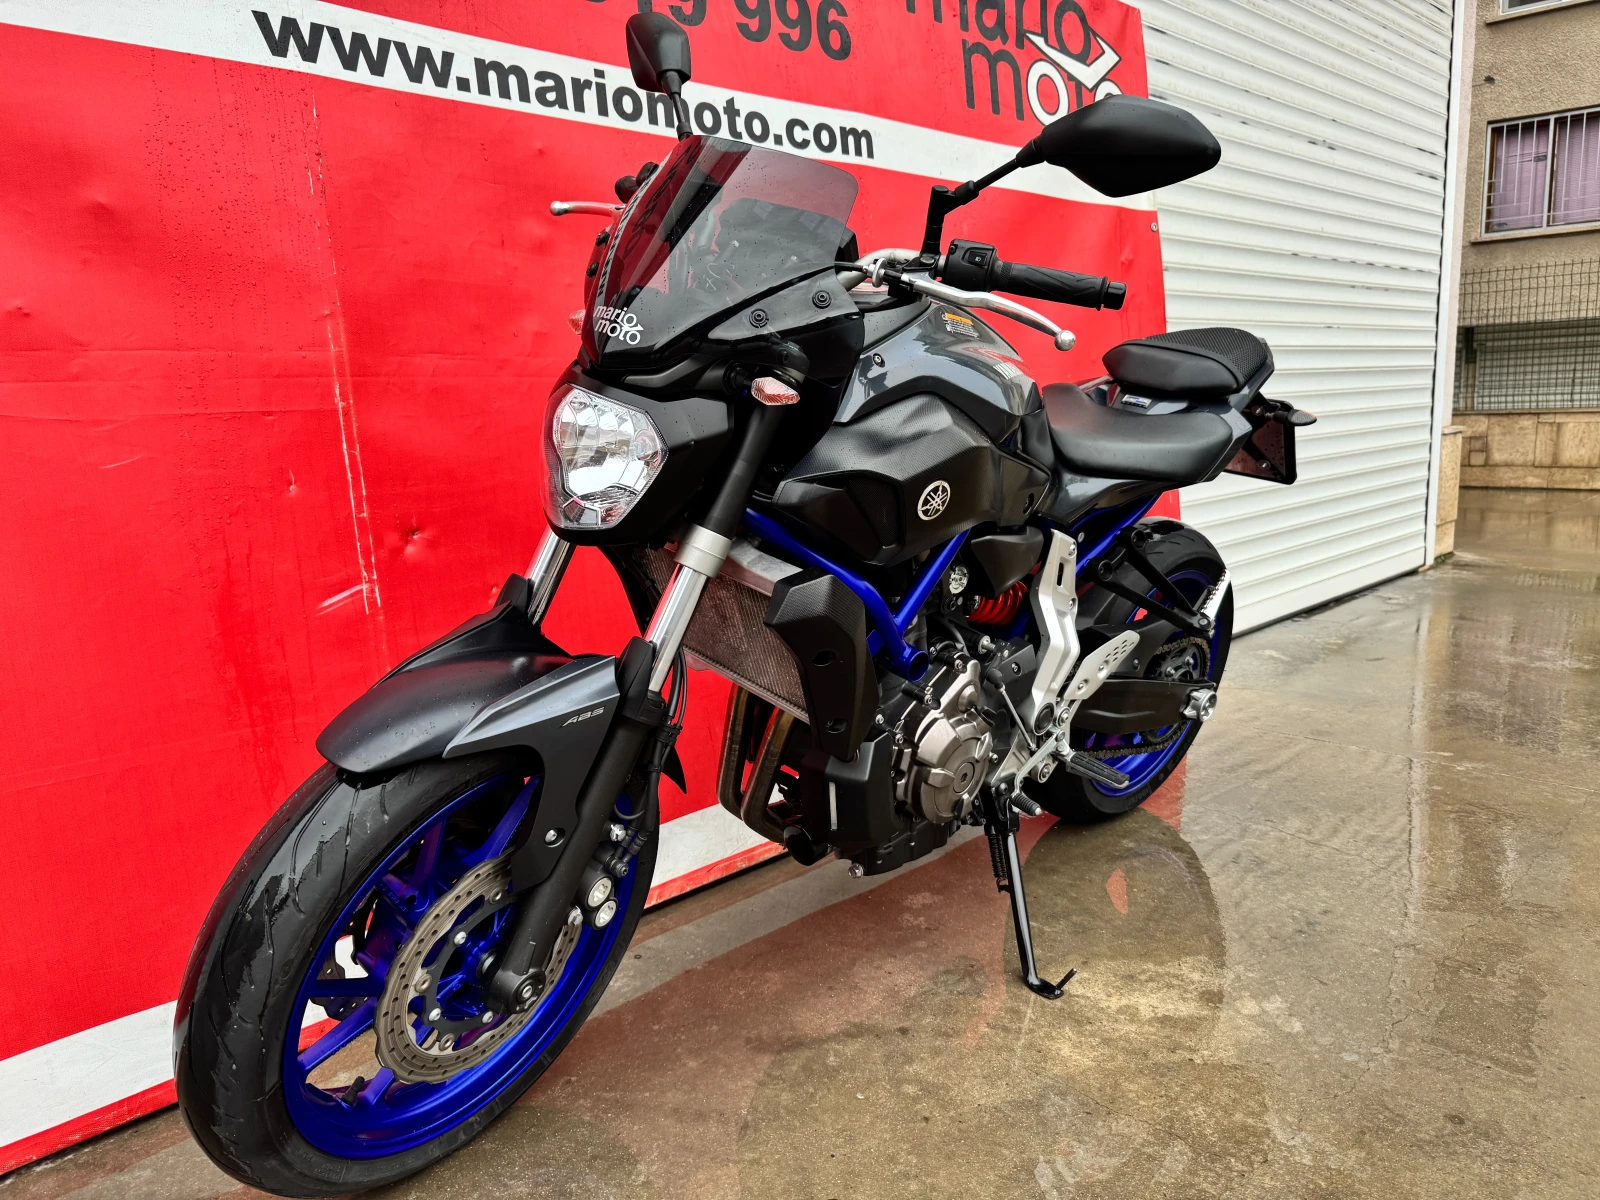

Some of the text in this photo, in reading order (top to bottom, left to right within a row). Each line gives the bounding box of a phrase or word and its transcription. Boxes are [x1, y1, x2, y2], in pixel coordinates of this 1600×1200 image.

[735, 0, 852, 61] 996
[251, 10, 874, 160] www.mariomoto.com
[593, 305, 637, 327] mario
[594, 319, 641, 345] moto
[562, 706, 605, 727] ABS
